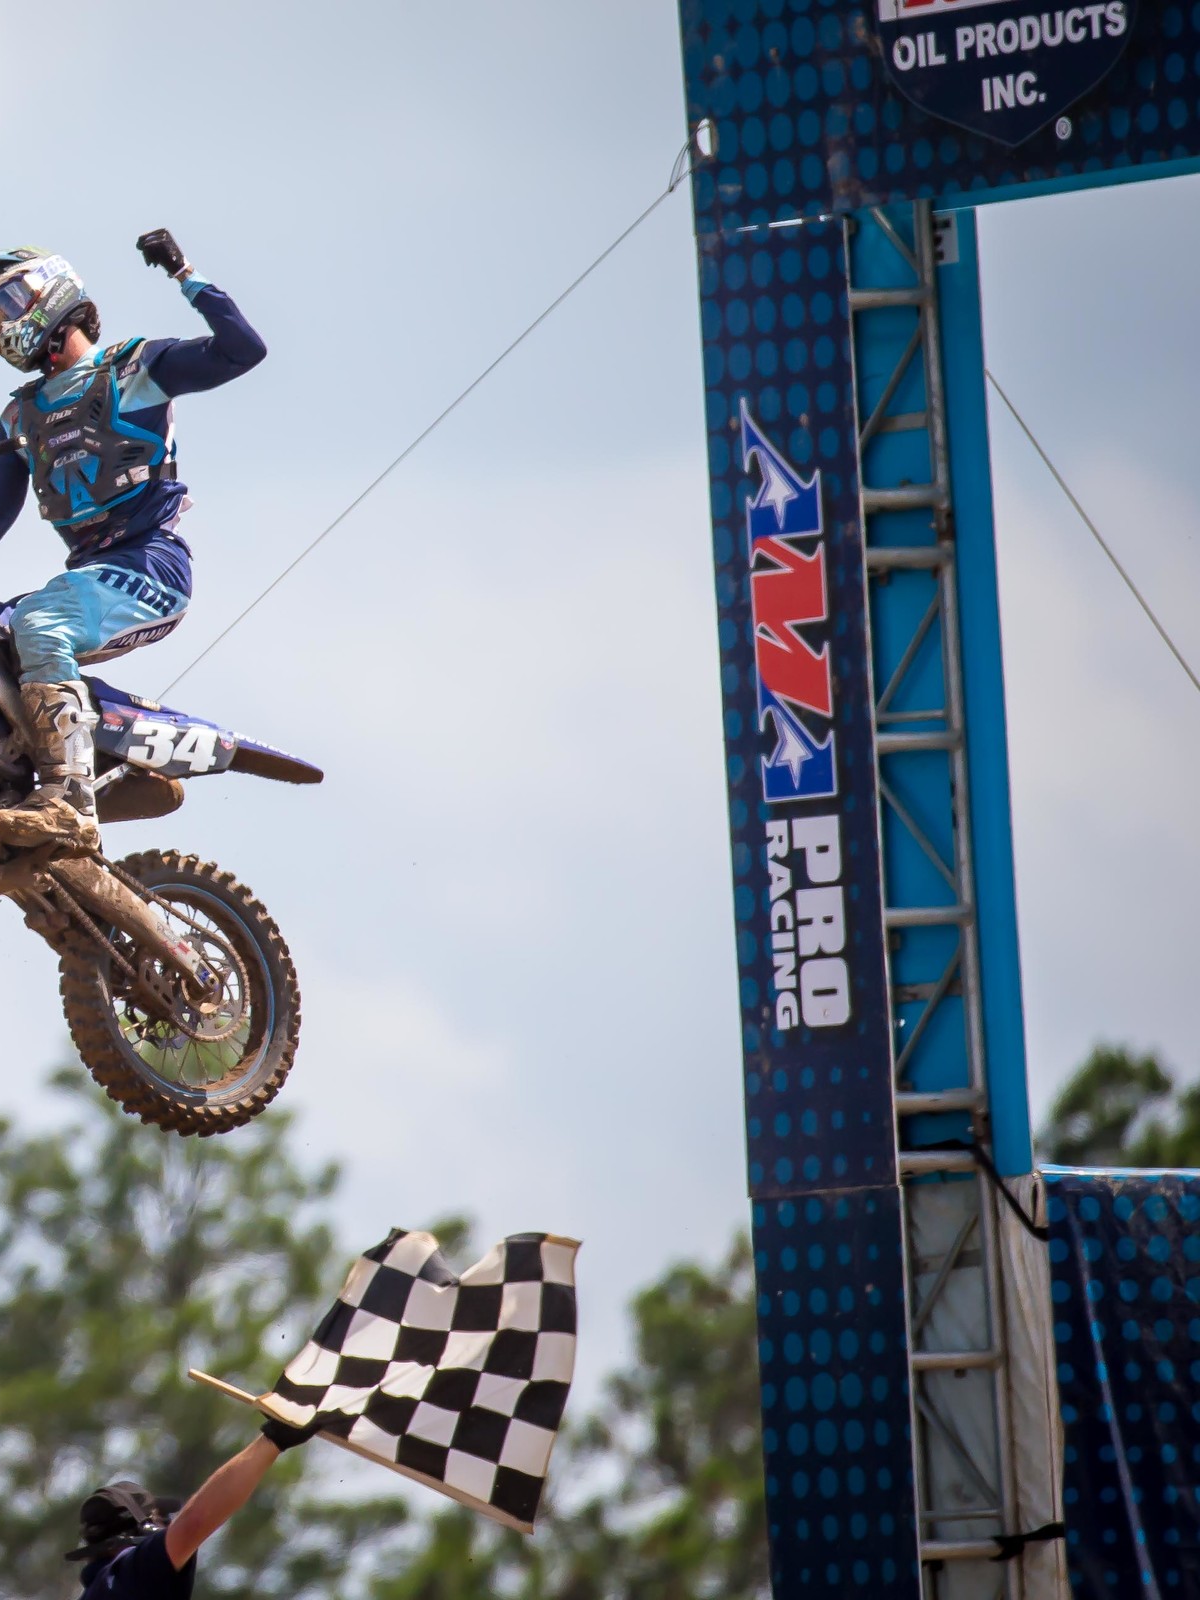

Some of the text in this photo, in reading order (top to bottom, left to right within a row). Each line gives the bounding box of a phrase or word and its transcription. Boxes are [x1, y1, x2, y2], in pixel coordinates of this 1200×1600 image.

[893, 1, 1127, 71] OIL PRODUCTS
[982, 71, 1046, 112] INC.
[95, 568, 177, 617] THOR
[127, 721, 218, 773] 34
[765, 819, 799, 1031] RACING
[792, 815, 850, 1028] PRO
